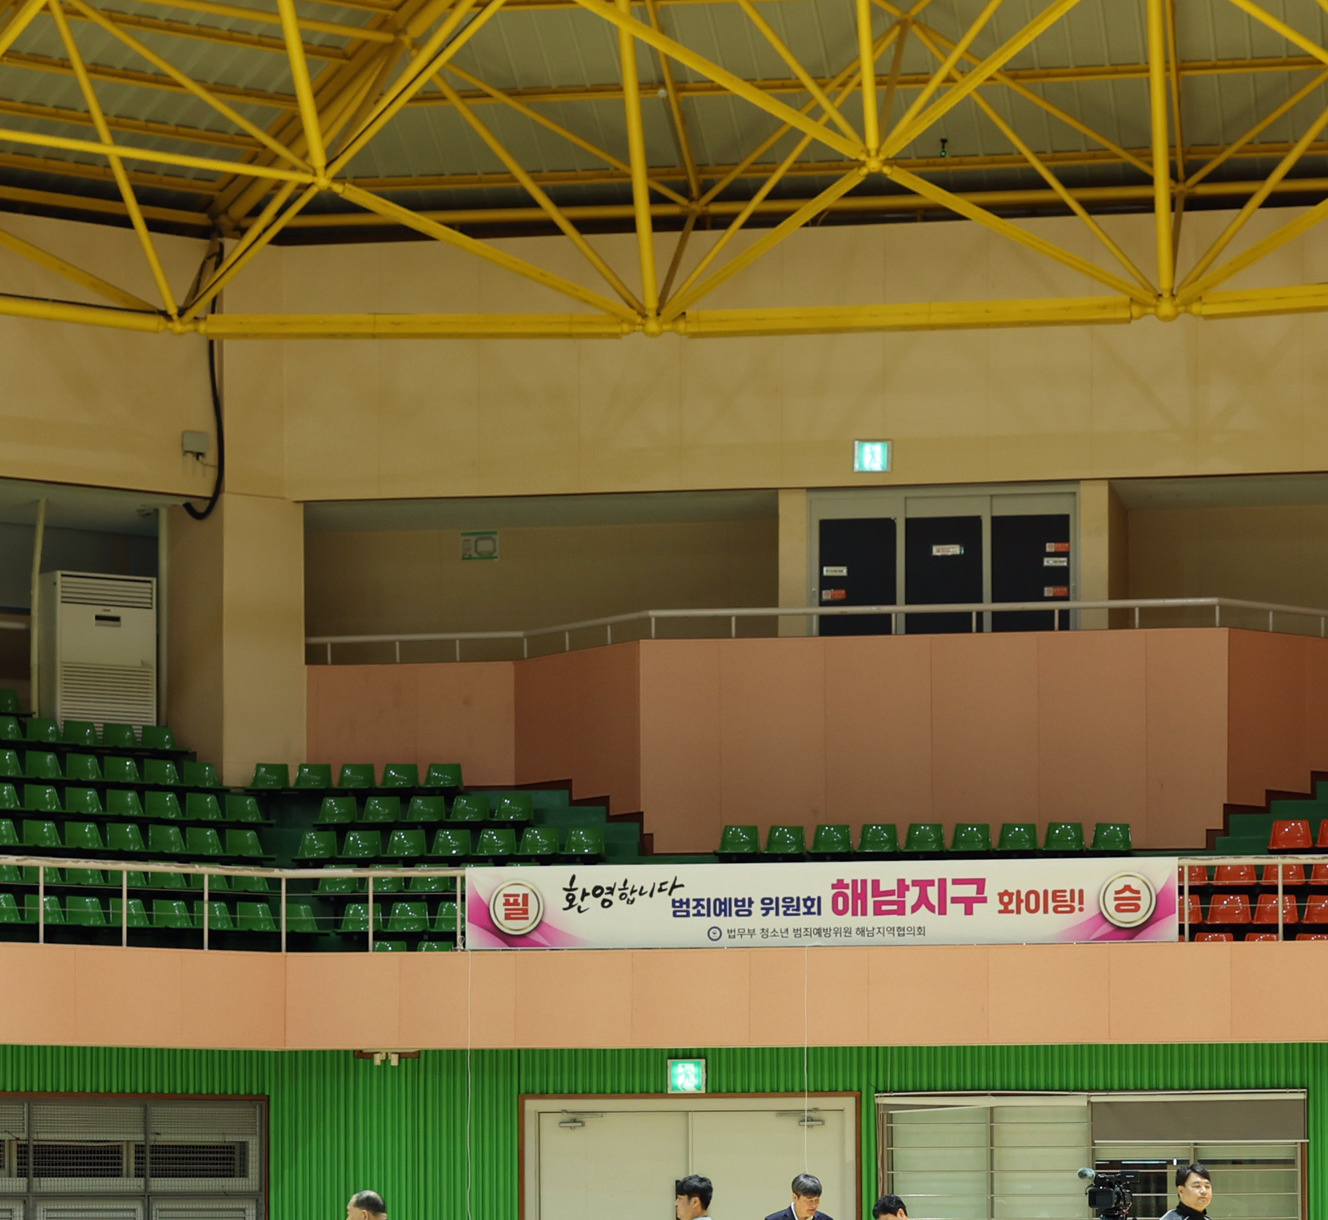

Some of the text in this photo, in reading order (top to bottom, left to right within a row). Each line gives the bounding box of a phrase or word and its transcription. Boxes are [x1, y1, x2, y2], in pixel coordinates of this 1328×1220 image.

[502, 892, 530, 921] 필
[562, 874, 685, 914] 환영합니다
[671, 877, 1085, 918] 범죄예방 위원회 해남지구 화이팅!
[1113, 884, 1142, 914] 승
[726, 926, 927, 940] 법무부 청소년 범죄예방위원 해남지역협의회
